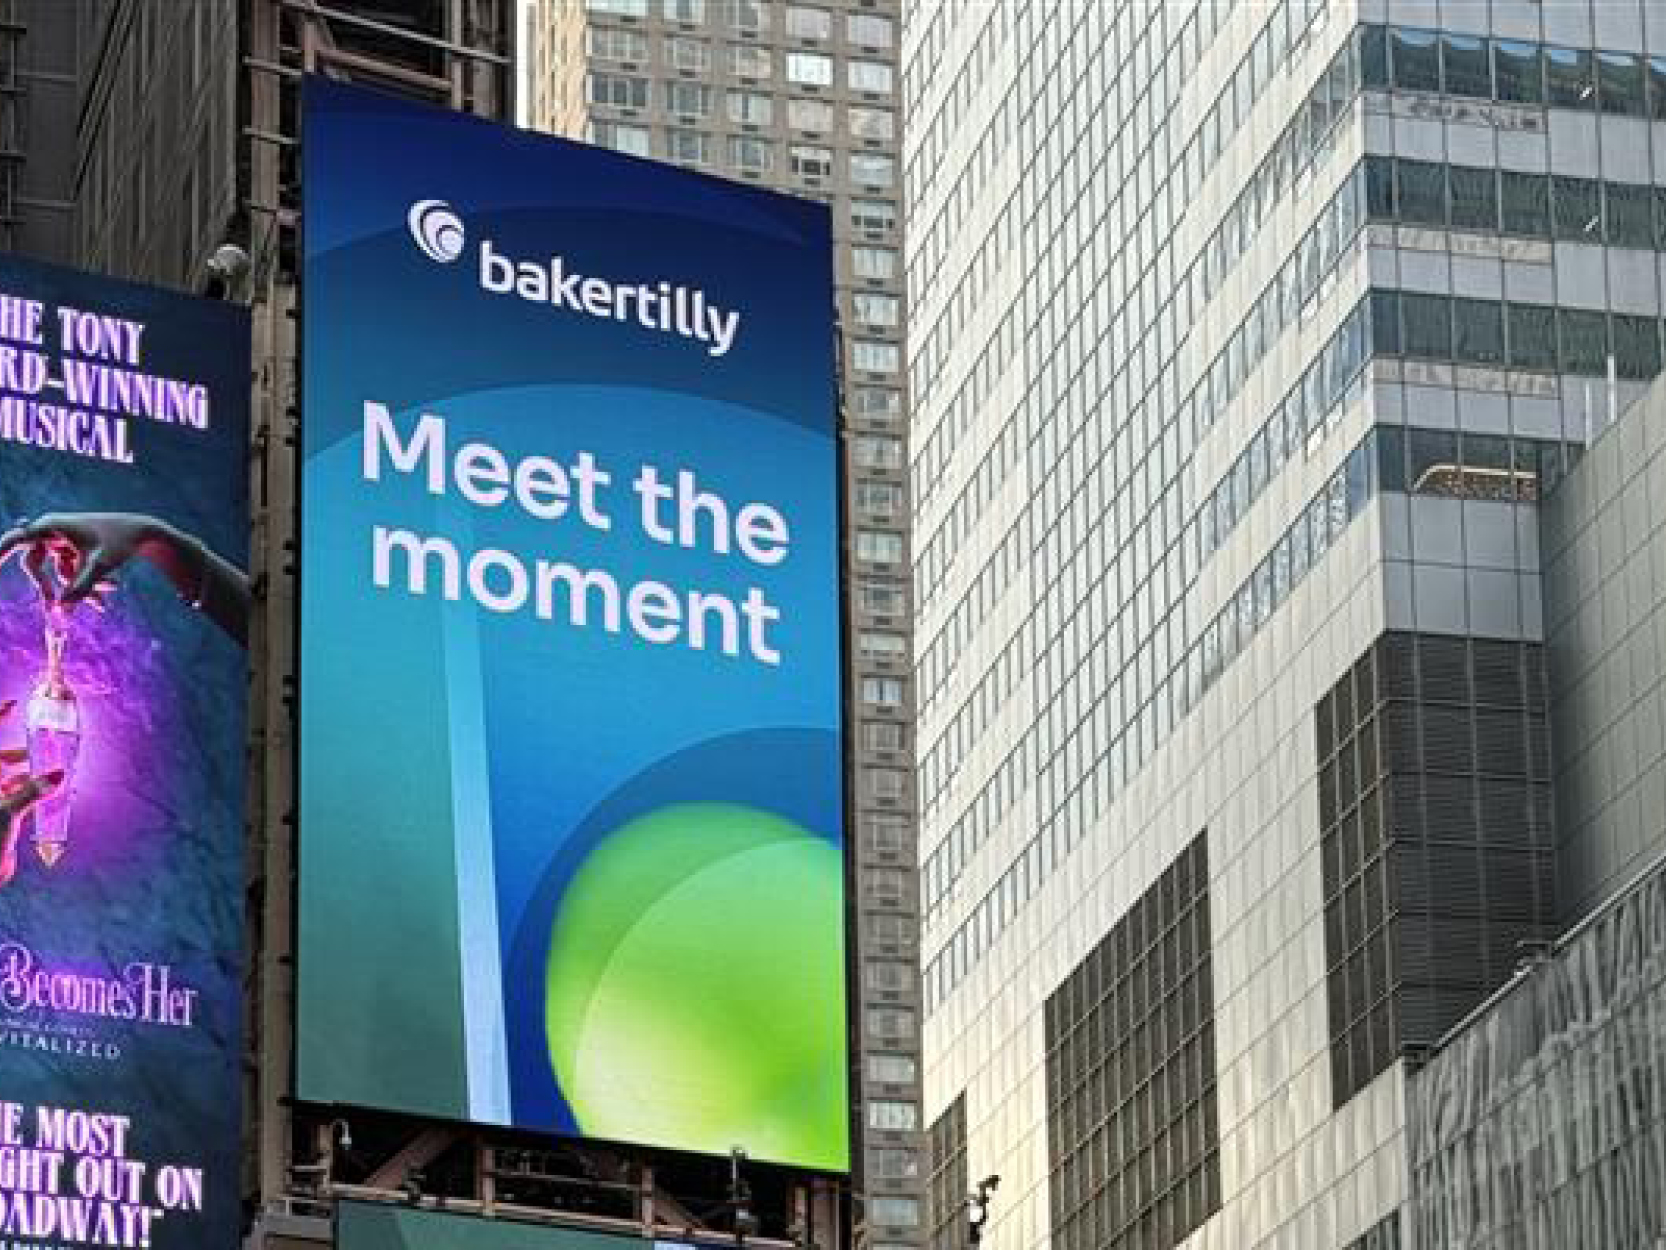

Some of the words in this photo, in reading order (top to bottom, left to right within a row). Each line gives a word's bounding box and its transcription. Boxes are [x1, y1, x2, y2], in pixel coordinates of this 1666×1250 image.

[480, 241, 740, 356] bakertilly
[57, 306, 146, 367] TONY
[362, 400, 612, 529] Meet
[633, 464, 790, 566] the
[372, 522, 782, 667] moment
[124, 962, 199, 1027] Her
[37, 1105, 130, 1158] MOST
[76, 1156, 147, 1204] OUT
[156, 1165, 203, 1211] ON
